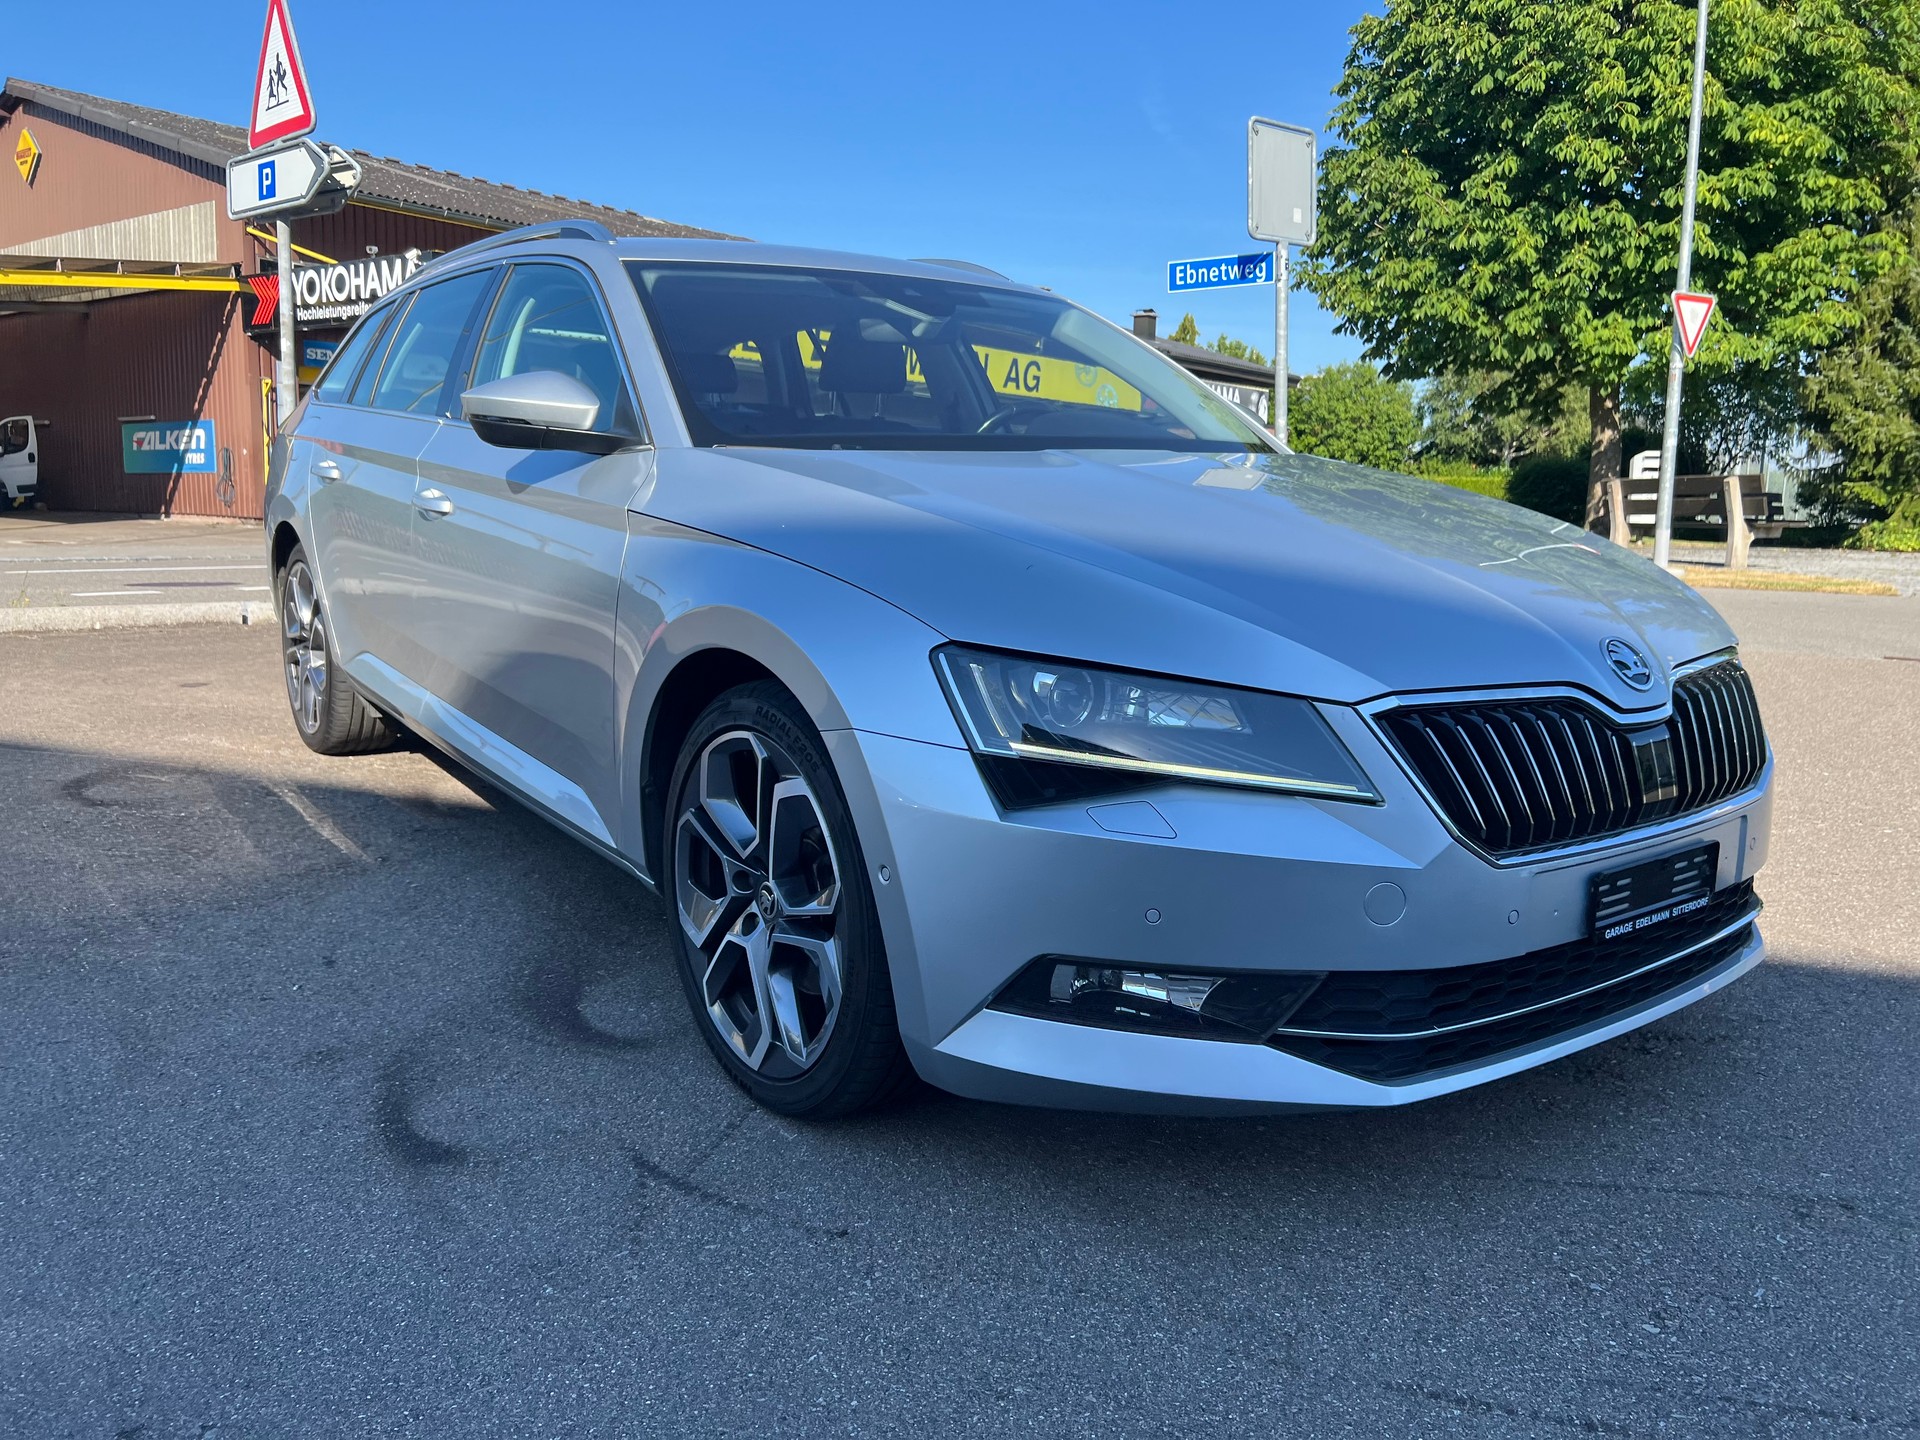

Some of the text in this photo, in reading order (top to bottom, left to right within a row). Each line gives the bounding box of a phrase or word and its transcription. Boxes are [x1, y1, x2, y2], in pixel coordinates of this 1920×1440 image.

[262, 167, 272, 196] P
[1175, 262, 1267, 283] Ebnetweg
[1002, 357, 1042, 393] AG
[132, 428, 206, 451] FALKEN
[184, 452, 205, 465] TYRES
[754, 704, 792, 738] RADIAL
[1605, 896, 1710, 940] GARAGE EDELMANN SITTERDORF
